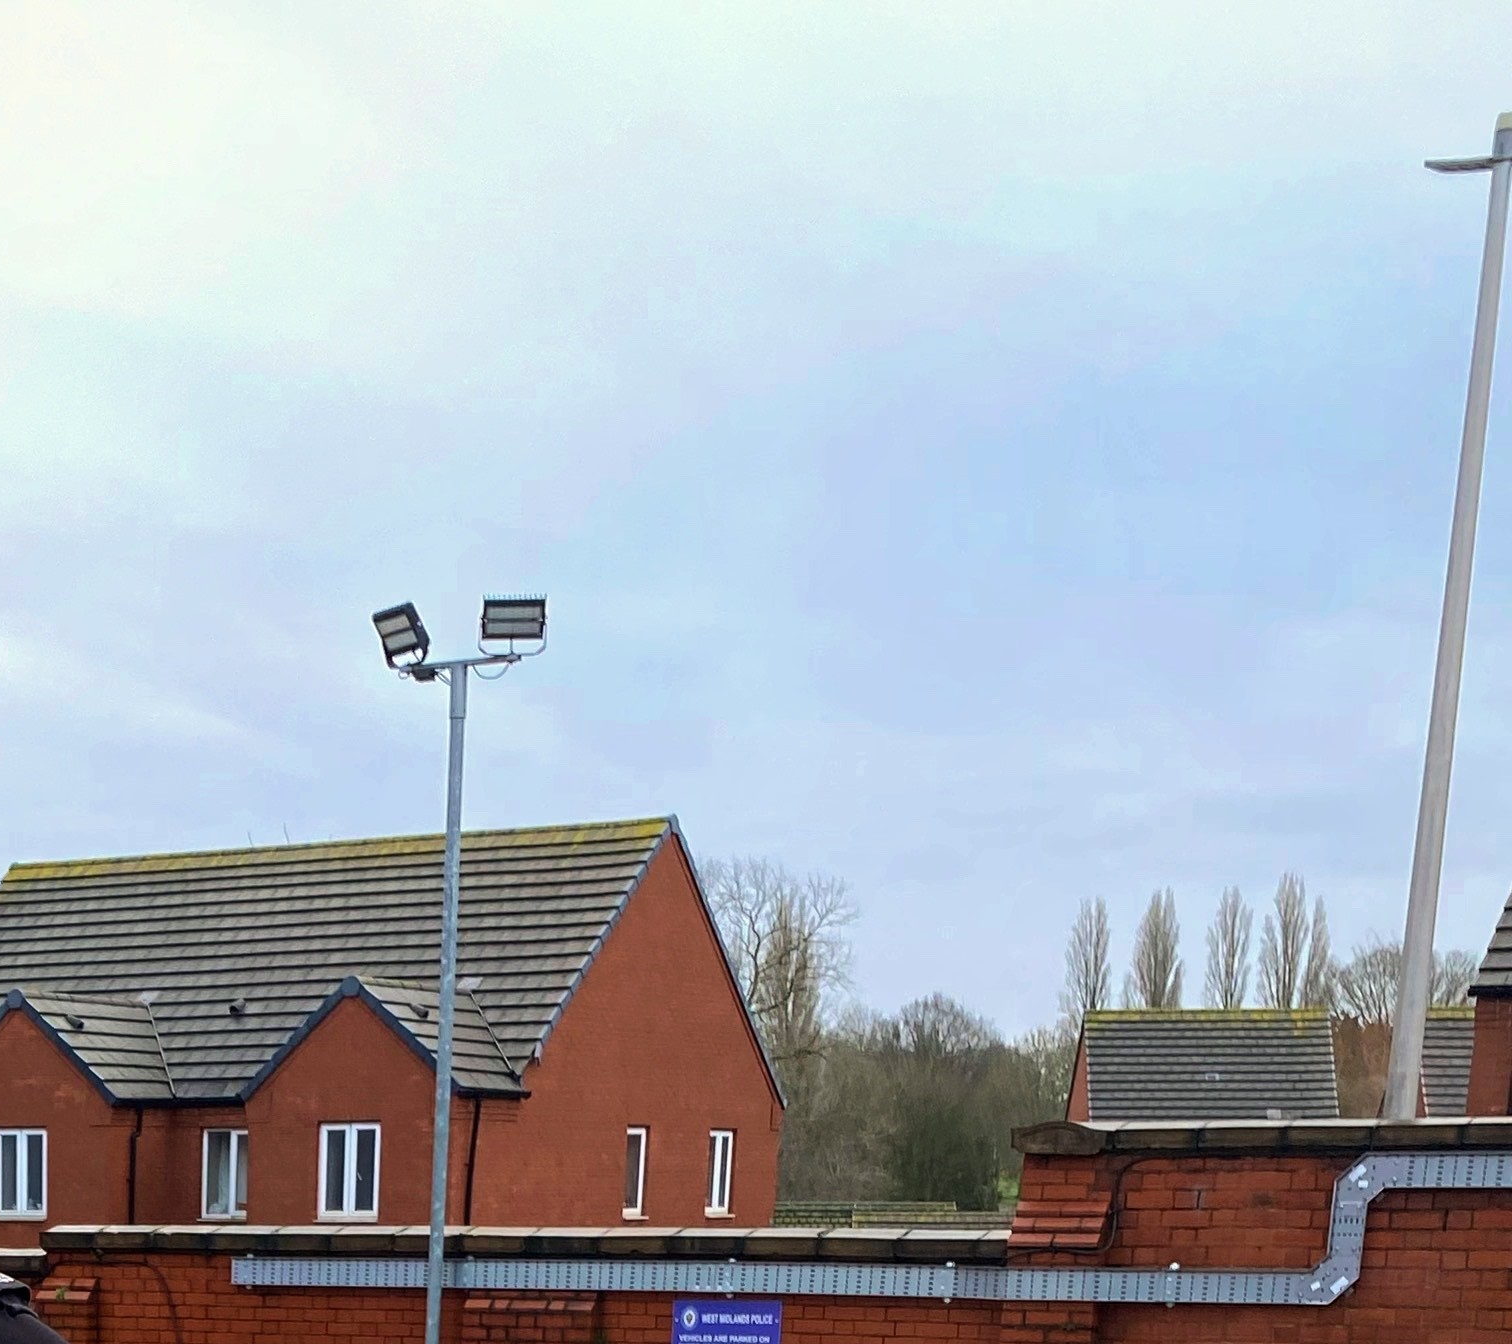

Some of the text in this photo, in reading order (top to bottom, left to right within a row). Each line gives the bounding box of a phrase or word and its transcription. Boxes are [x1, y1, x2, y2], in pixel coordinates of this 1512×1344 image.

[701, 1313, 773, 1325] WEST MIDLANDS POLICE
[679, 1334, 770, 1344] VEHICLES ARE PARKED ON
